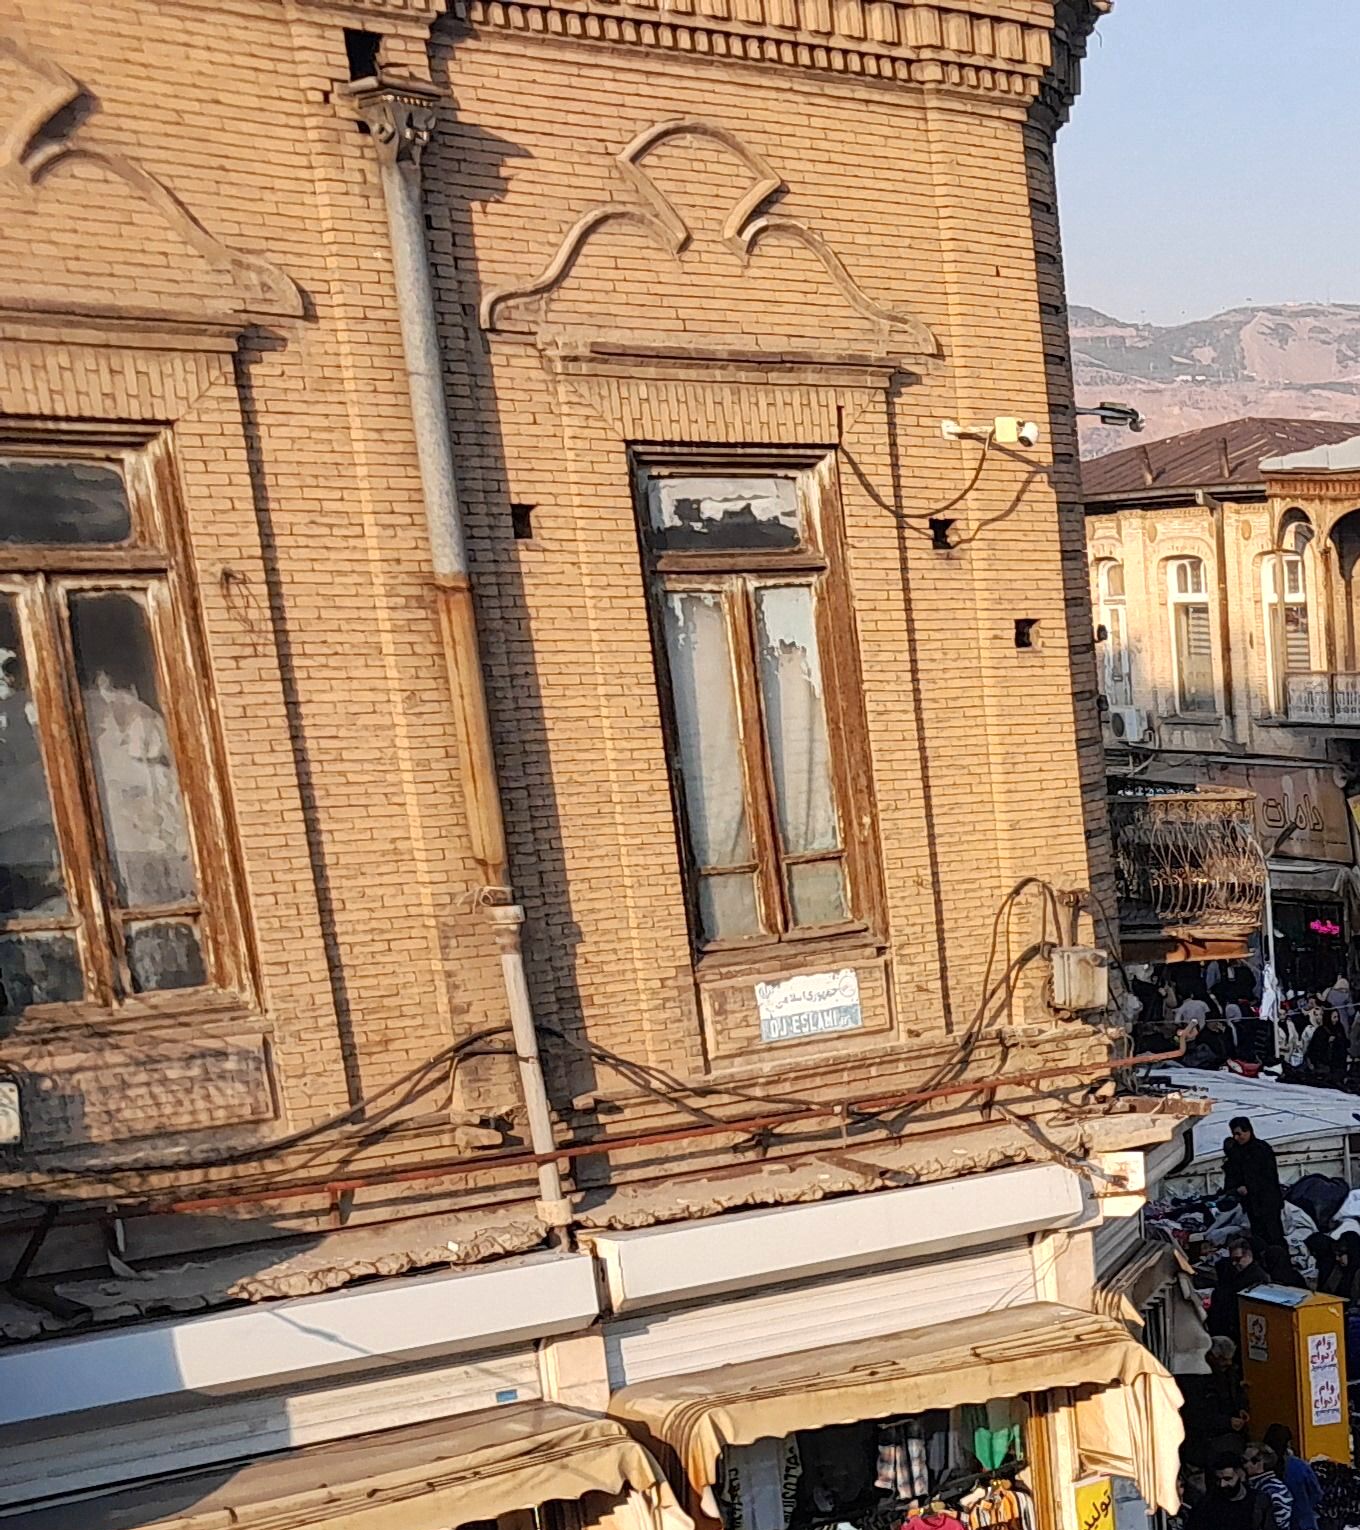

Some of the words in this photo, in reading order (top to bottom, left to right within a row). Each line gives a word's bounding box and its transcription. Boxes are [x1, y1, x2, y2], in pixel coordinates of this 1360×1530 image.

[792, 1009, 838, 1034] ESLAMI
[1316, 1336, 1331, 1350] وام
[1319, 1381, 1335, 1395] وام
